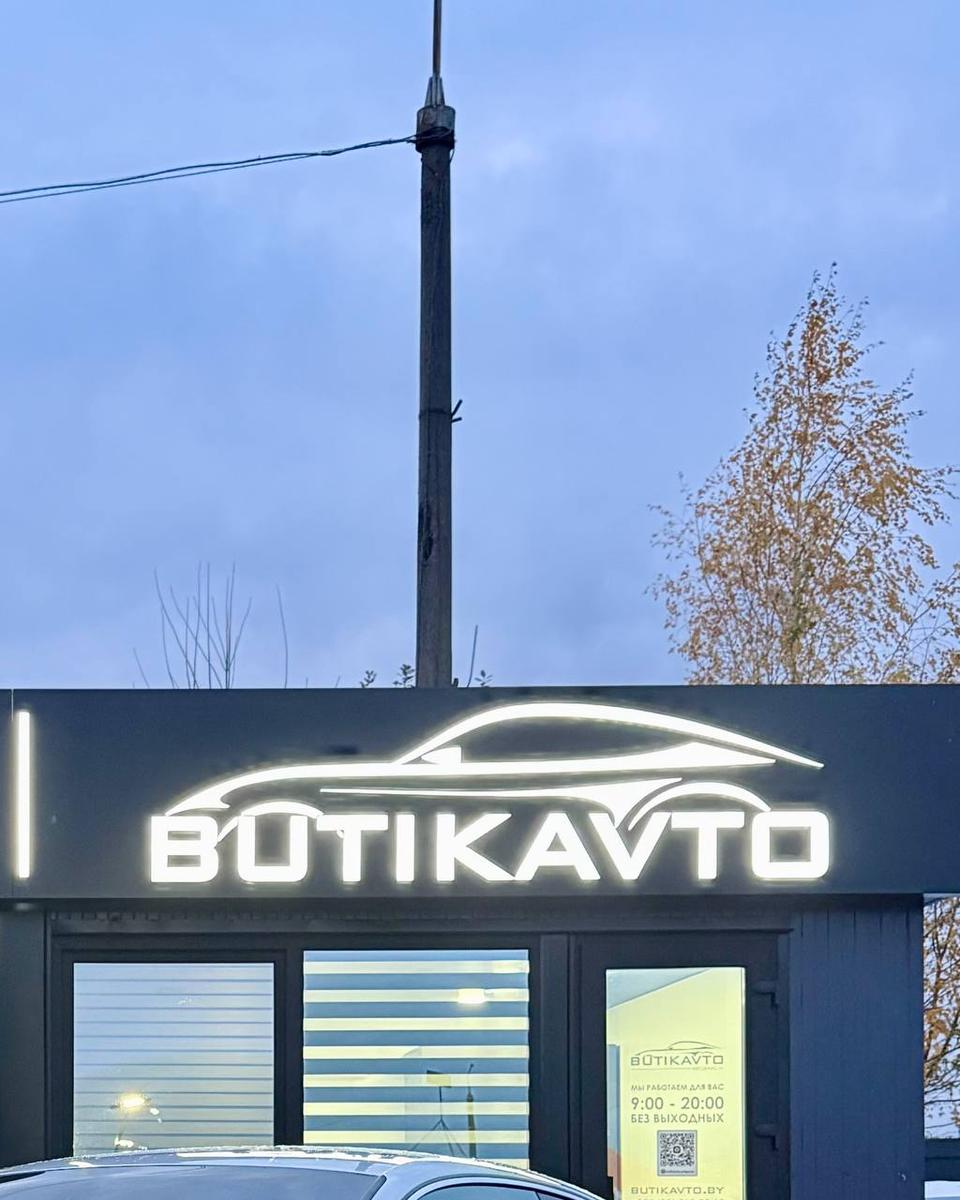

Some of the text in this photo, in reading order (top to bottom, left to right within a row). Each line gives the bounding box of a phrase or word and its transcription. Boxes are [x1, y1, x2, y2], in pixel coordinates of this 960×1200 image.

[149, 809, 831, 883] BUTIKAVTO
[630, 1055, 724, 1066] BUTIKAVTO
[707, 1083, 725, 1091] ВАС
[631, 1096, 664, 1110] 9:00
[680, 1096, 724, 1110] 20:00
[631, 1113, 725, 1124] БЕЗ ВЫХОДНЫХ
[631, 1186, 725, 1195] BUTIKAVTO.BY
